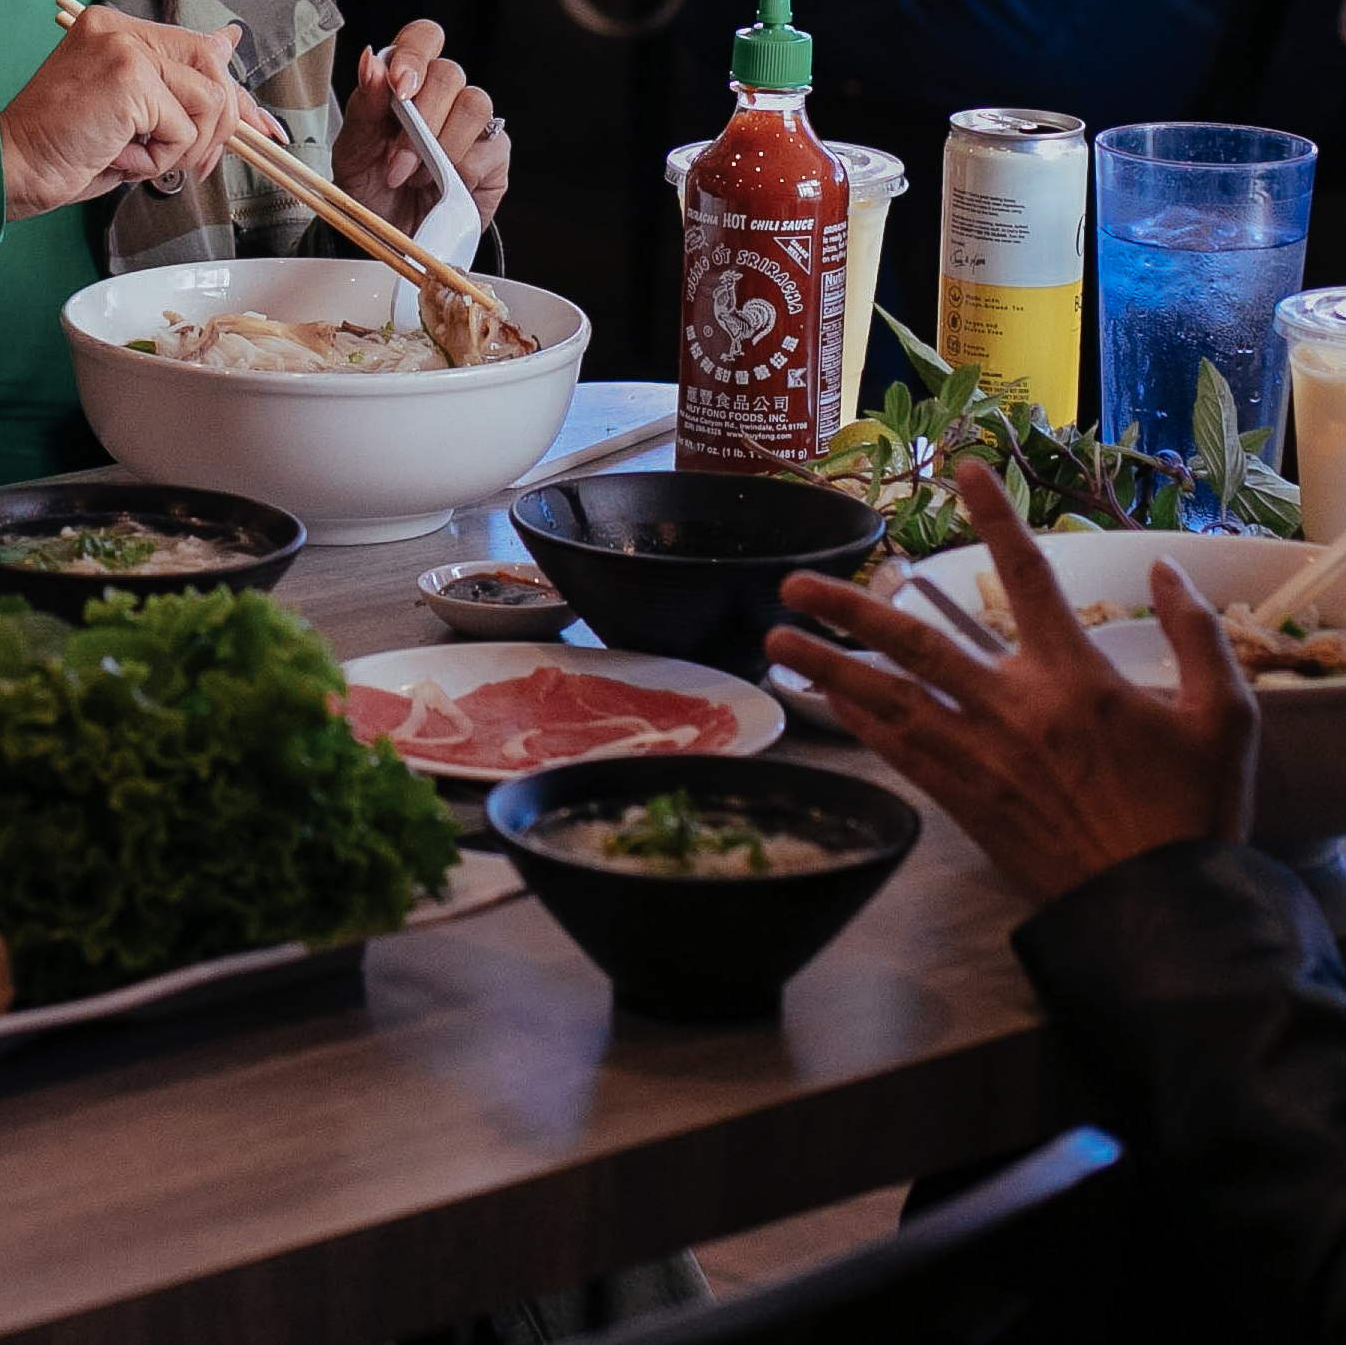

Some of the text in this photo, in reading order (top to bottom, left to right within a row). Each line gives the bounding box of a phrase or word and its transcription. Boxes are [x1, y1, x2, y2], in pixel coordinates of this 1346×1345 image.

[722, 212, 747, 231] HOT
[750, 219, 780, 232] CHILI
[781, 218, 815, 231] SAUCE
[736, 249, 804, 315] SRIRACHA
[685, 403, 701, 416] HUY
[702, 408, 726, 422] FONG
[728, 412, 766, 424] FOODS,
[768, 413, 789, 424] INC.
[699, 416, 724, 429] Canyon
[739, 422, 775, 432] Irwindale,
[775, 423, 788, 431] CA
[696, 441, 706, 452] 17
[706, 446, 721, 456] oz.
[734, 449, 747, 458] lb.
[797, 448, 808, 460] g)
